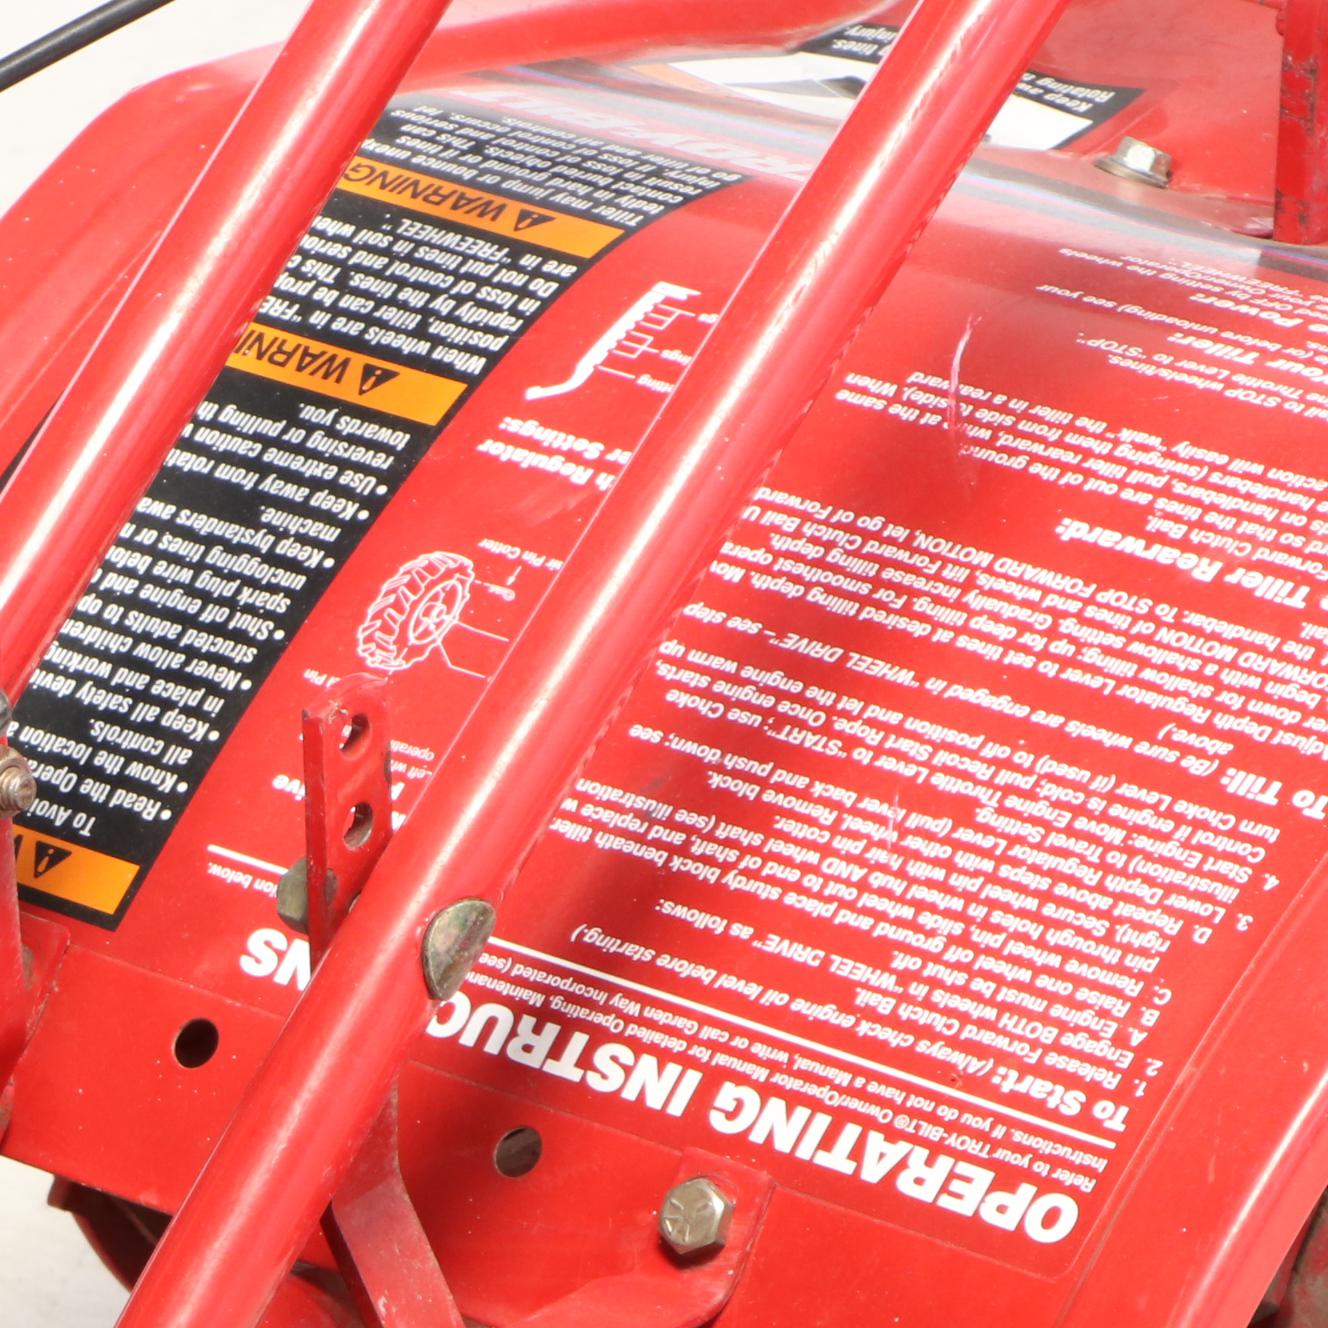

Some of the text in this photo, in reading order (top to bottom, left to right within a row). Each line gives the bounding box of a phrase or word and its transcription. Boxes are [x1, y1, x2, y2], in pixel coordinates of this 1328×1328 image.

[1039, 77, 1115, 102] Rotating
[1043, 92, 1093, 112] Keep
[342, 160, 507, 222] WARNING
[312, 287, 509, 351] position, tiller can be
[233, 329, 351, 383] WARNI
[308, 310, 486, 374] When wheels are in
[835, 390, 942, 425] at the same
[217, 404, 394, 469] reversing or pulling
[299, 403, 410, 450] towards you.
[498, 417, 604, 459] Settings:
[194, 427, 376, 495] Use extreme caution
[476, 439, 594, 484] Regulator
[214, 463, 359, 520] Keep away from
[175, 509, 324, 568] Keep bystanders
[260, 506, 341, 541] machine.
[1145, 515, 1187, 539] Bail.
[134, 528, 306, 590] unclogging tines or
[478, 539, 545, 567] Pin Cotter
[1189, 529, 1252, 557] Clutch
[1055, 517, 1310, 608] Tiller Rearward:
[152, 560, 290, 613] spark plug wire
[99, 572, 274, 640] Shut off engine and
[103, 604, 257, 663] structed adults to
[132, 642, 241, 690] Never allow
[110, 667, 224, 717] in place and
[665, 689, 724, 718] Choke
[75, 681, 209, 741] Keep all safety
[727, 708, 762, 727] use
[19, 726, 177, 793] Know the location
[90, 719, 192, 765] all controls.
[852, 748, 873, 765] to
[873, 755, 929, 783] Lever
[79, 778, 161, 820] Read the
[930, 772, 1001, 808] Throttle
[72, 813, 95, 836] To
[1004, 795, 1072, 828] Engine
[1073, 817, 1126, 846] Move
[975, 801, 1239, 903] illustration) to Travel Setting.
[1127, 833, 1202, 868] Engine:
[208, 862, 259, 888] below.
[1203, 856, 1252, 883] Start
[1263, 873, 1279, 890] 4.
[655, 899, 727, 934] follows:
[729, 923, 753, 939] as
[908, 982, 929, 1001] in
[930, 989, 997, 1020] wheels
[547, 993, 624, 1033] Operating,
[571, 924, 1129, 1132] To Start: (Always check engine oil level before starting.)
[998, 1012, 1058, 1044] BOTH
[624, 1024, 687, 1052] detailed
[687, 1045, 711, 1062] for
[855, 987, 1146, 1097] 1. Release Forward Clutch Bail.
[1060, 1032, 1134, 1068] Engage
[478, 953, 1107, 1172] Instructions. If you do not have a Manual, write or call Garden Way Incorporated (see
[711, 1052, 769, 1082] Manual
[1146, 1058, 1163, 1076] 2.
[238, 924, 1078, 1243] OPERATING INSTRUCNS
[770, 1073, 893, 1123] Owner/Operator
[987, 1148, 1032, 1168] your
[1032, 1161, 1050, 1176] to
[1051, 1168, 1096, 1192] Refer
